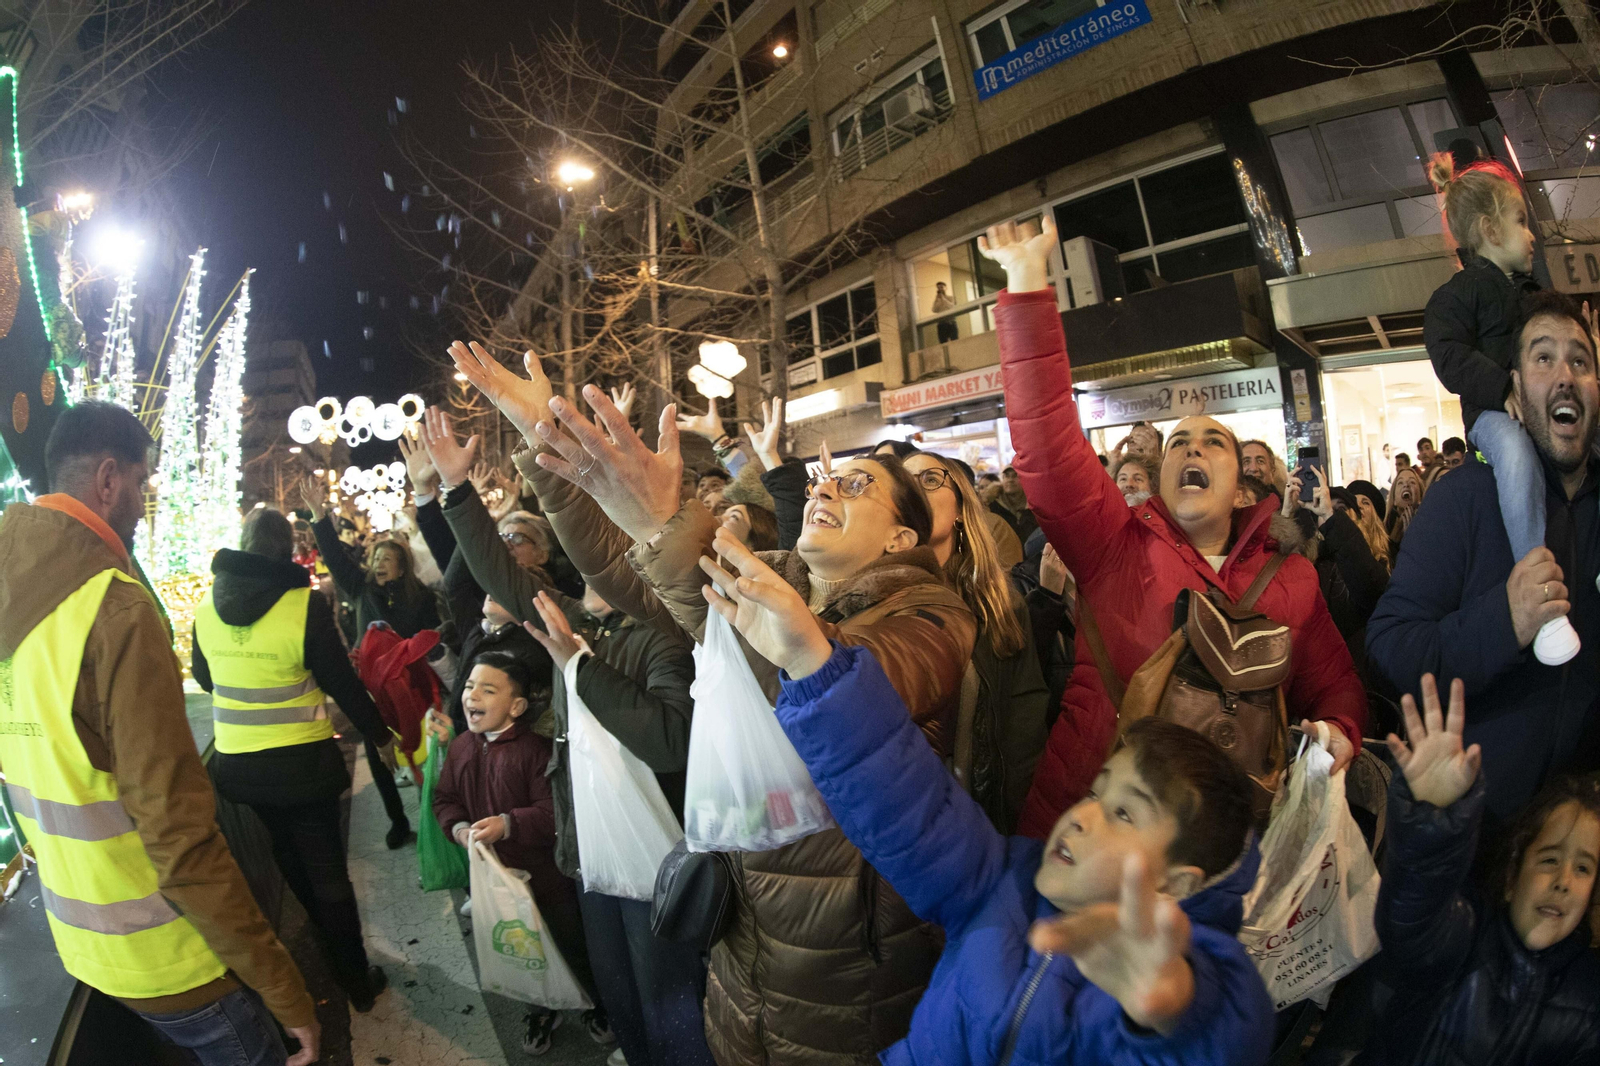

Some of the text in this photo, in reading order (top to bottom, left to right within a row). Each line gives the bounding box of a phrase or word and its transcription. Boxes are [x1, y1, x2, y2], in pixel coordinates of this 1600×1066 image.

[1007, 4, 1136, 73] mediterráneo
[1016, 15, 1141, 77] ADMINISTRACIÓN DE FINCAS
[890, 390, 921, 410] MINI
[925, 376, 980, 401] MARKET
[1179, 378, 1276, 404] PASTELERIA
[1275, 969, 1293, 983] 953
[1287, 958, 1328, 988] LINARES
